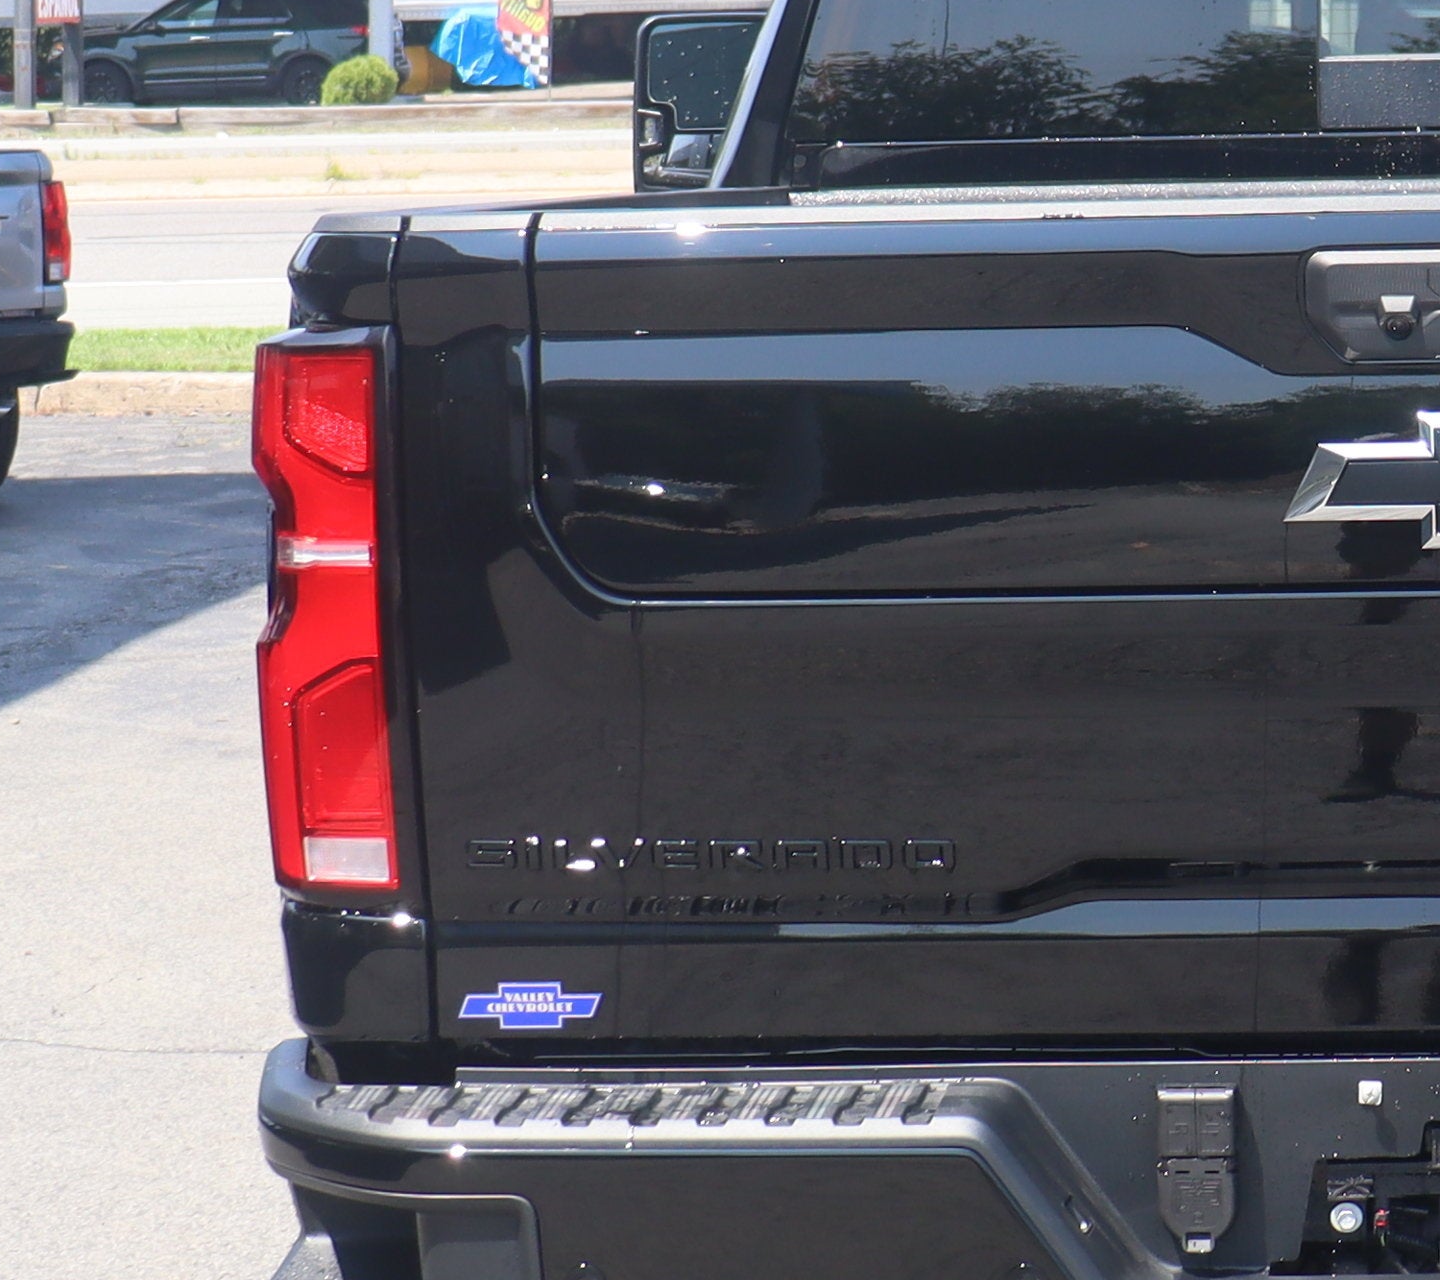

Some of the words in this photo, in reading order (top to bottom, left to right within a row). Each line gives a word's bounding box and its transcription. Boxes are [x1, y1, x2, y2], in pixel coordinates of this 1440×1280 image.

[465, 837, 957, 872] SILVERADO
[504, 991, 556, 1002] VALLEY
[486, 1001, 573, 1013] CHEVROLET
